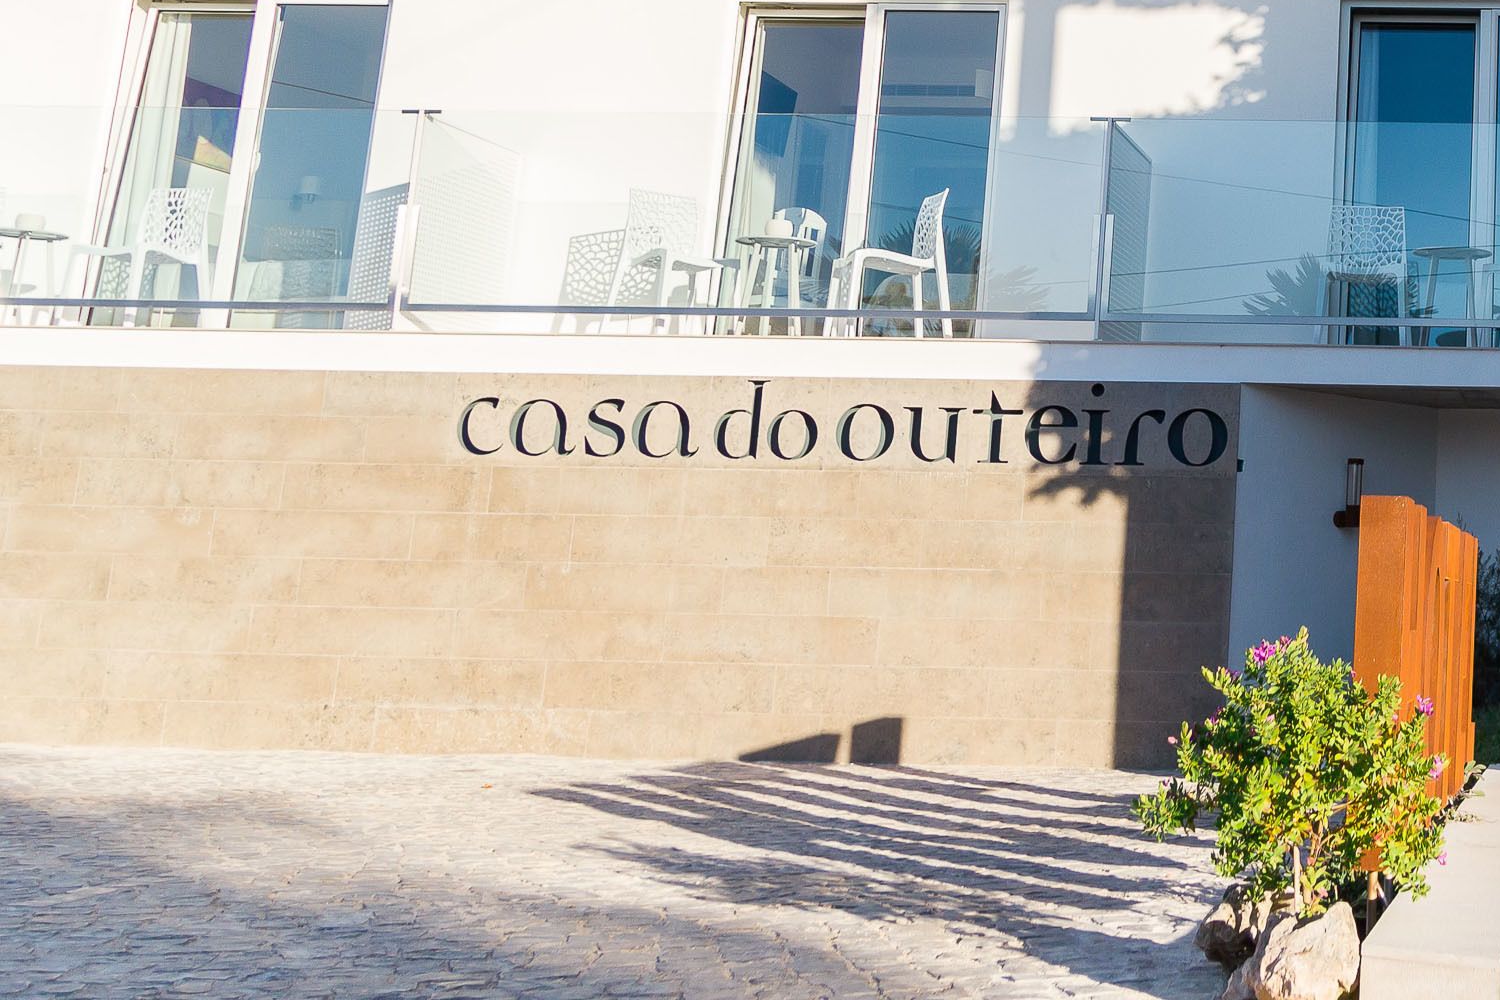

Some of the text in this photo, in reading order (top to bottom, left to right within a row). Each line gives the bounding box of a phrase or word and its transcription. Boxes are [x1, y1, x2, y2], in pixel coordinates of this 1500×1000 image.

[457, 380, 1228, 466] casa do outeiro
